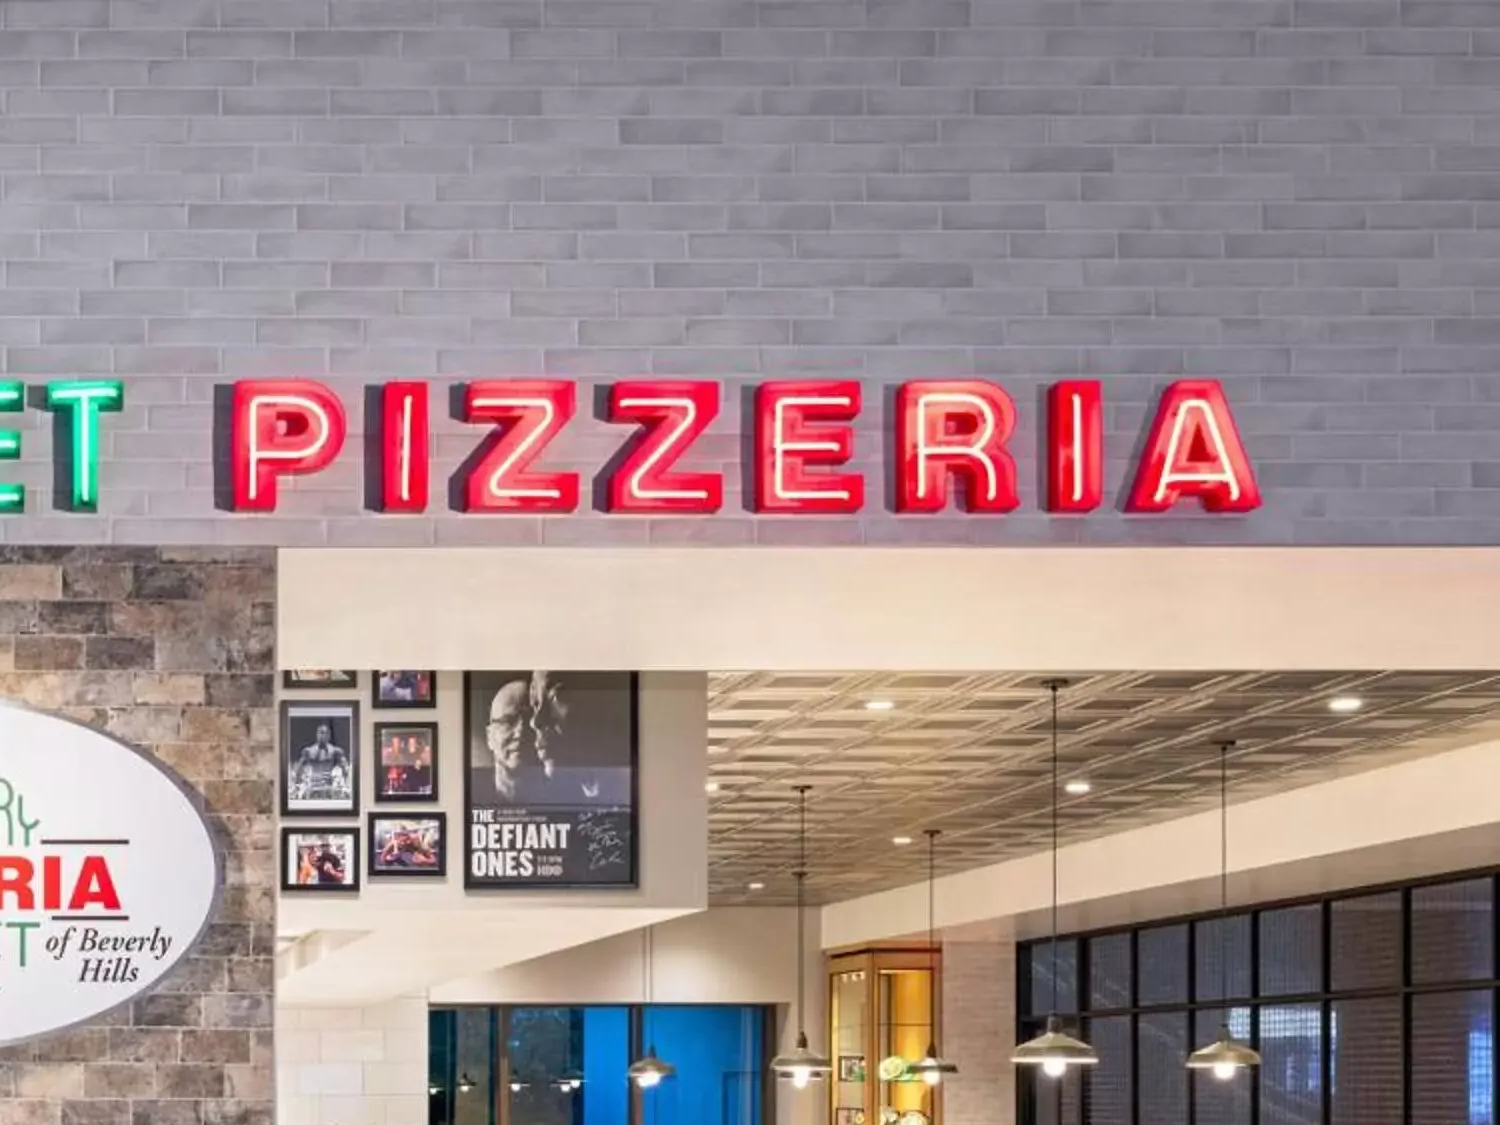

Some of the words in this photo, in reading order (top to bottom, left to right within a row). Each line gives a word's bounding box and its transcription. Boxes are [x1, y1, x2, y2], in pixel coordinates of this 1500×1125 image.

[231, 380, 1262, 513] PIZZERIA
[472, 809, 495, 823] THE
[471, 823, 571, 849] DEFIANT
[471, 851, 534, 877] ONES
[45, 926, 77, 960] of
[79, 927, 172, 960] Beverly
[79, 957, 140, 982] Hills
